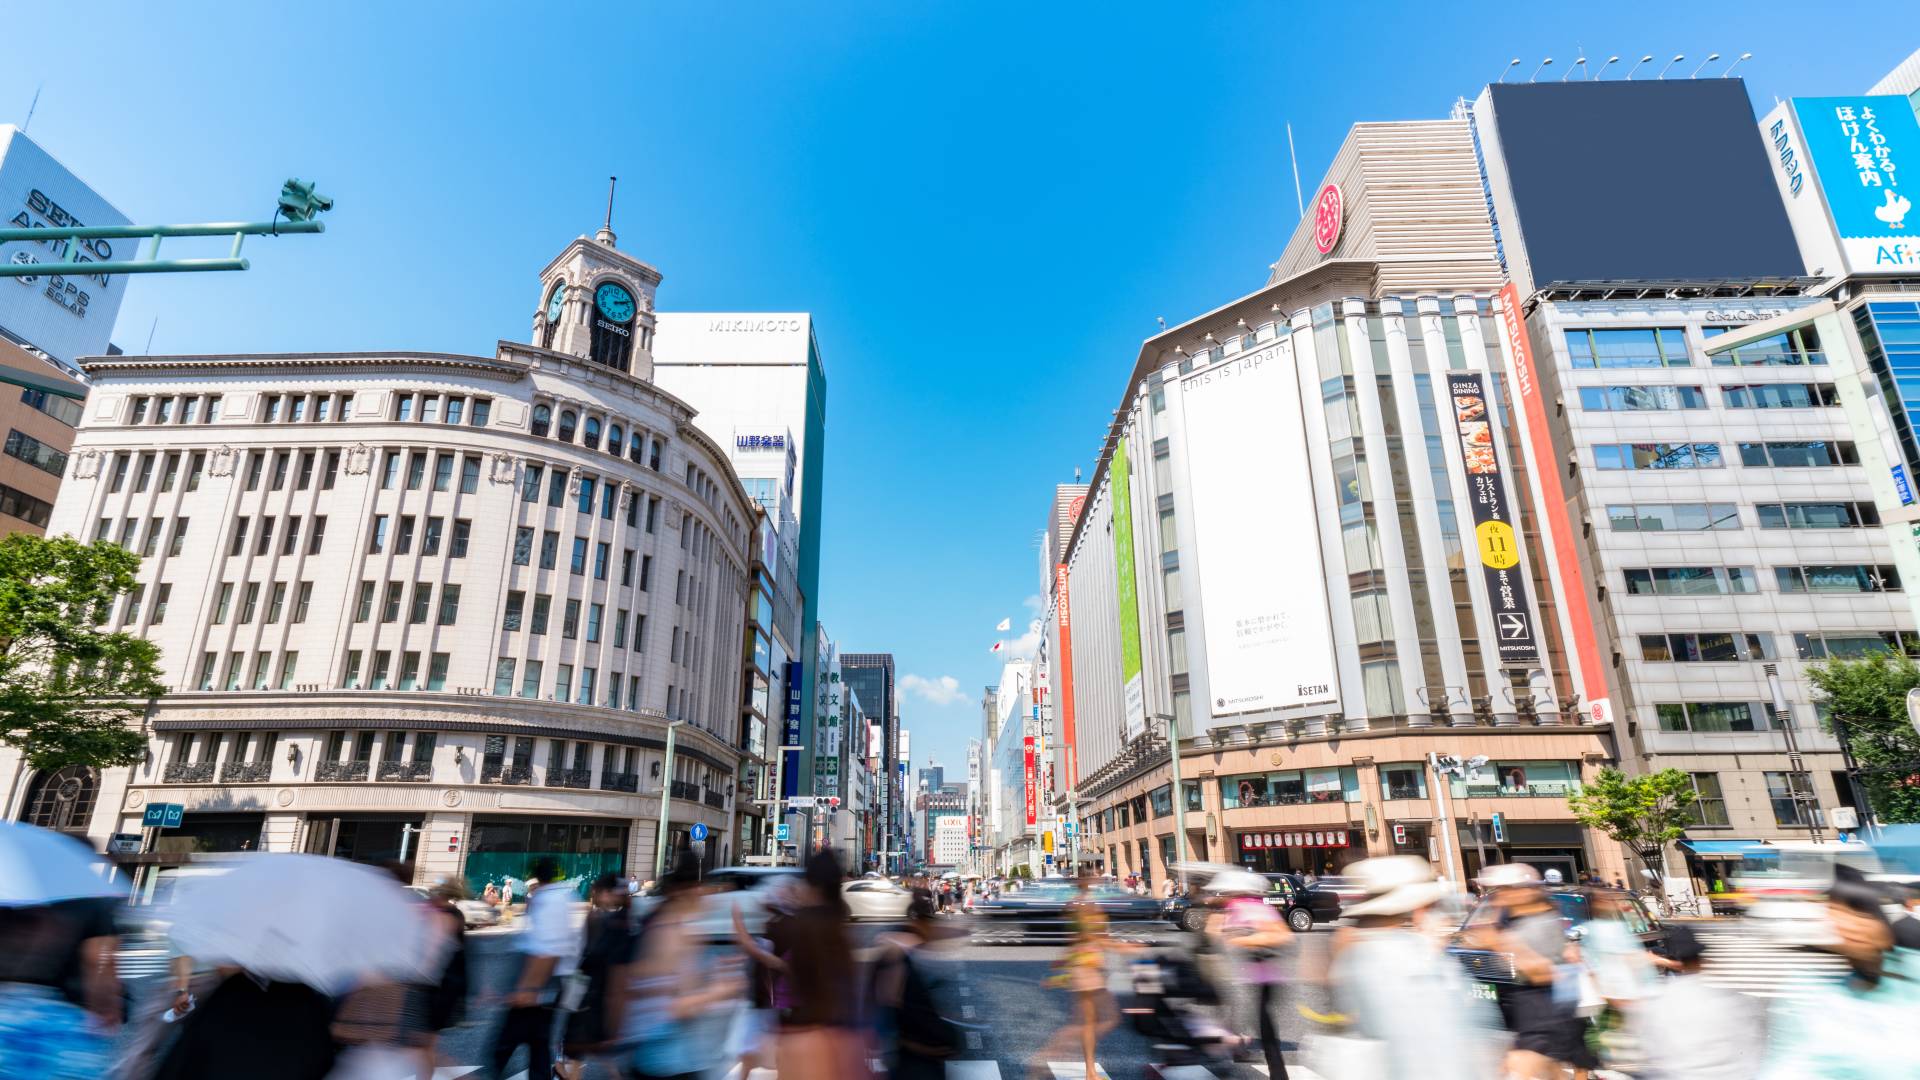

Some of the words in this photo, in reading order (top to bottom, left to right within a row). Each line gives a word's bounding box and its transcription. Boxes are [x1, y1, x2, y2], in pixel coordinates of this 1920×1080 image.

[1770, 119, 1802, 193] アフラック
[1836, 106, 1882, 187] ほけん案内
[44, 287, 86, 319] SOLAR
[597, 320, 630, 337] SEIKO
[707, 320, 801, 333] MIKIMOTO
[1503, 293, 1532, 396] MITSUKOSHI
[1181, 373, 1212, 392] this
[1058, 568, 1068, 626] MITSUKOSHI
[828, 672, 840, 728] 教文館
